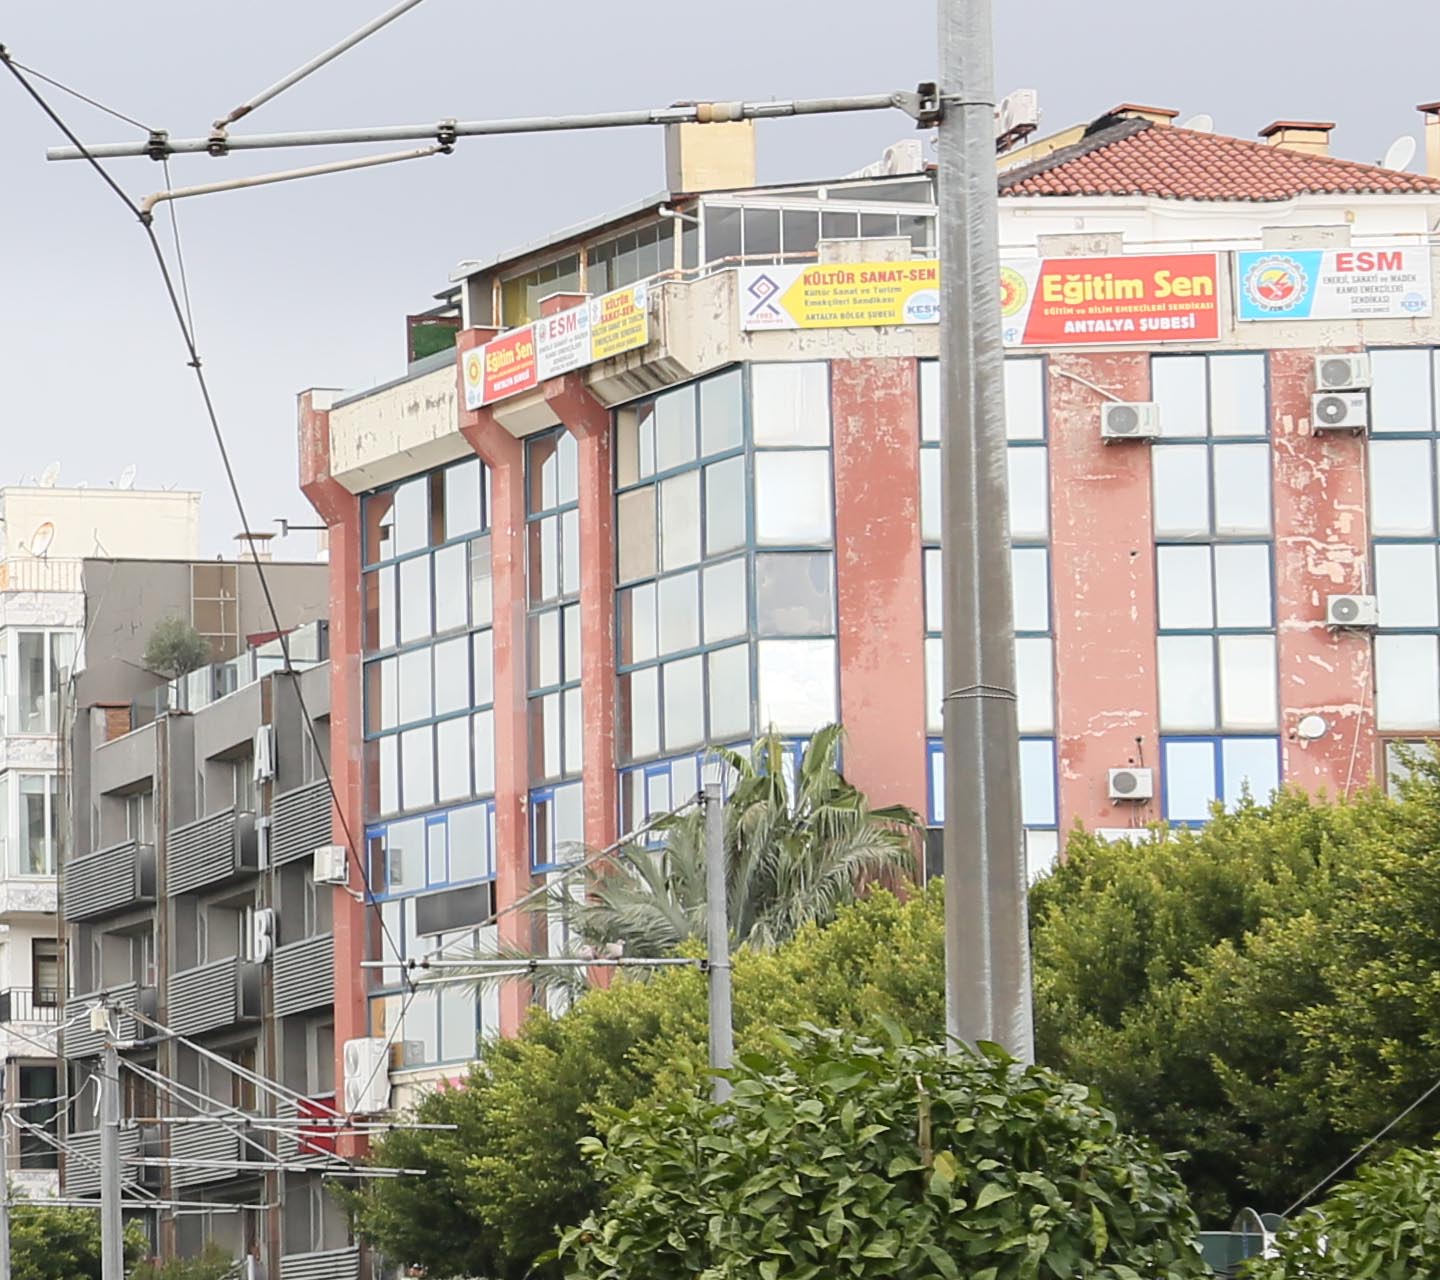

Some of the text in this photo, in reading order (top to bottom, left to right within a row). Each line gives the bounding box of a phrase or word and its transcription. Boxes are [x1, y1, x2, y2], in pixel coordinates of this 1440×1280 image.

[1336, 251, 1403, 272] ESM
[803, 268, 936, 286] KÜLTÜR SANAT-SEN
[1042, 270, 1213, 305] Eğitim Sen
[833, 286, 858, 296] Sanat
[549, 313, 577, 338] ESM
[1064, 312, 1195, 334] ANTALYA ŞUBESİ
[486, 348, 514, 373] Eğitim
[516, 341, 533, 362] Sen
